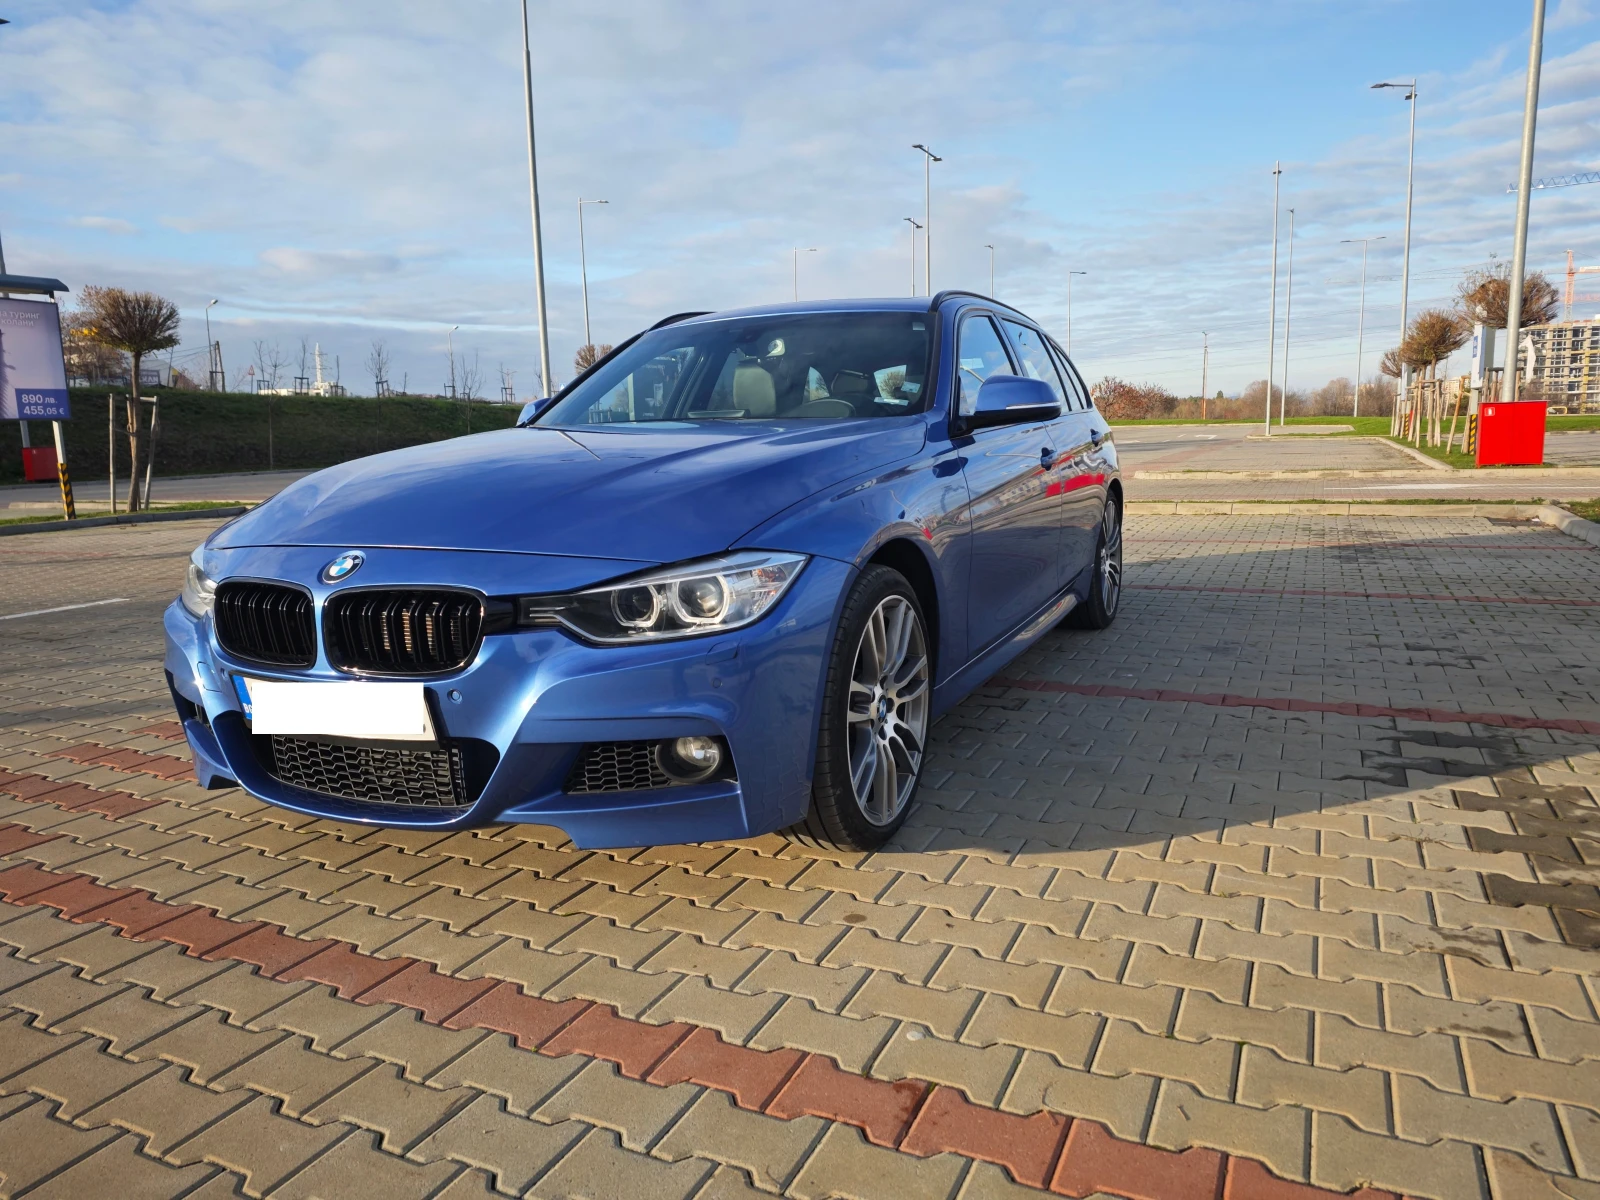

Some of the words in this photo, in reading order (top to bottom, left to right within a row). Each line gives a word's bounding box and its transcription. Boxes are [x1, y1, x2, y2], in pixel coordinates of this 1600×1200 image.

[9, 311, 40, 320] туринг
[1, 319, 34, 327] колани
[21, 394, 43, 404] 890
[24, 405, 58, 417] 455,05
[59, 407, 65, 415] €
